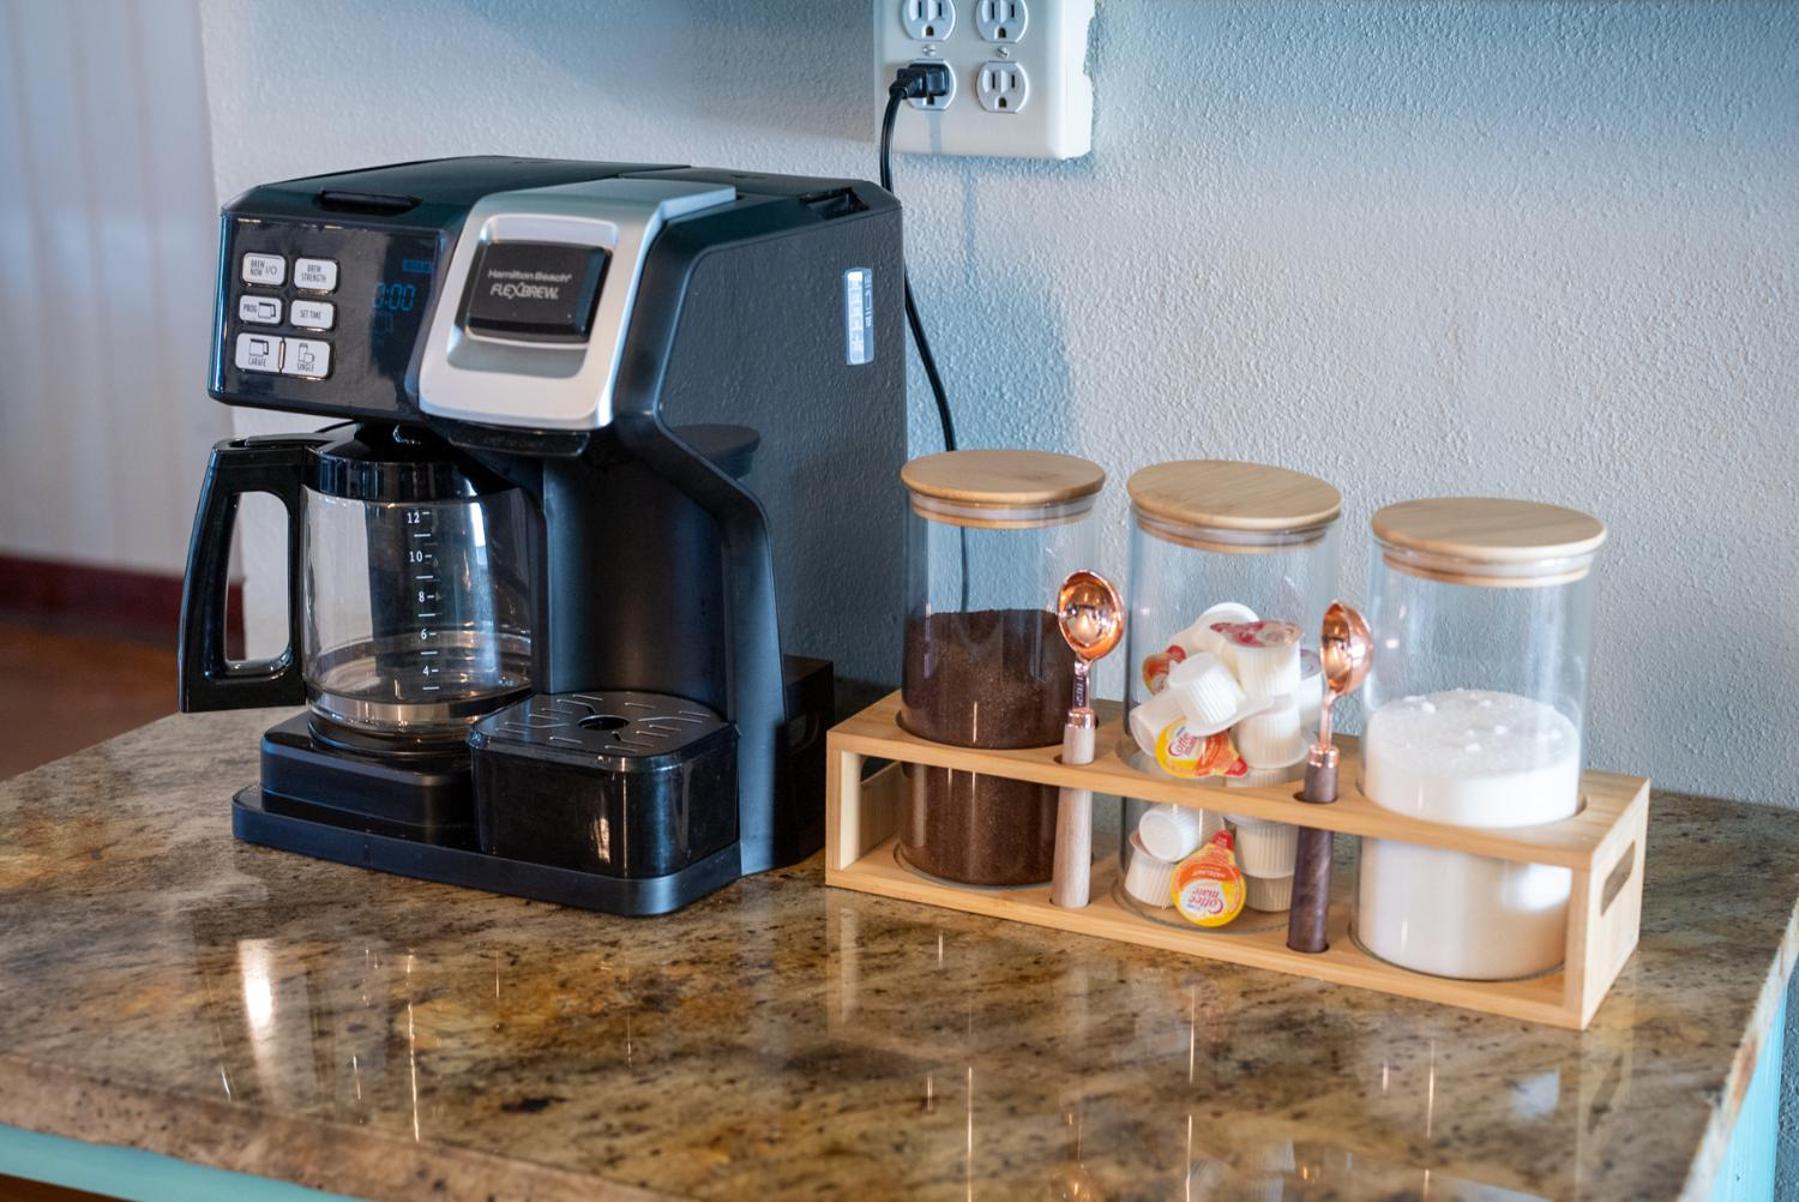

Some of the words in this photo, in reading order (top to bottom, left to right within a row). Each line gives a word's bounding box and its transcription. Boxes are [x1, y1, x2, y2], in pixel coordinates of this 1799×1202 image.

[487, 268, 534, 280] Hamilton
[407, 511, 421, 524] 12
[409, 550, 423, 563] 10
[418, 590, 425, 603] 8
[420, 628, 428, 640] 6
[422, 665, 429, 677] 4
